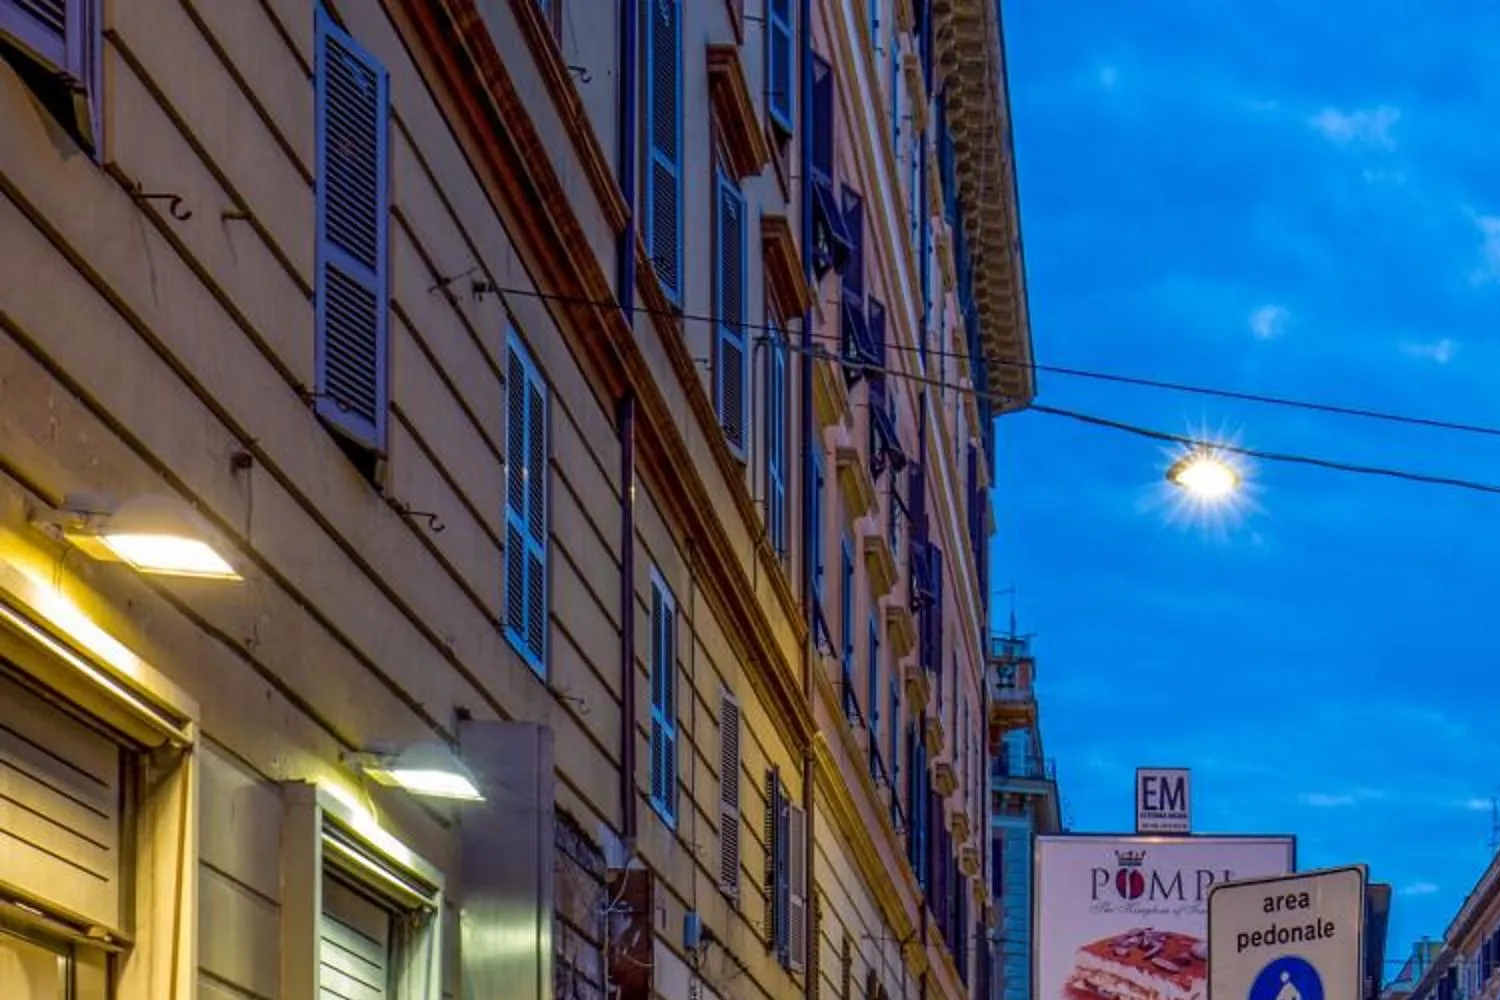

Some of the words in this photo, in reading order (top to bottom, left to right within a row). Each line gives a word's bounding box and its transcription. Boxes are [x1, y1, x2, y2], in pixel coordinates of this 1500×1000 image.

[1142, 776, 1185, 810] EM
[1263, 892, 1310, 913] area
[1237, 917, 1335, 953] pedonale
